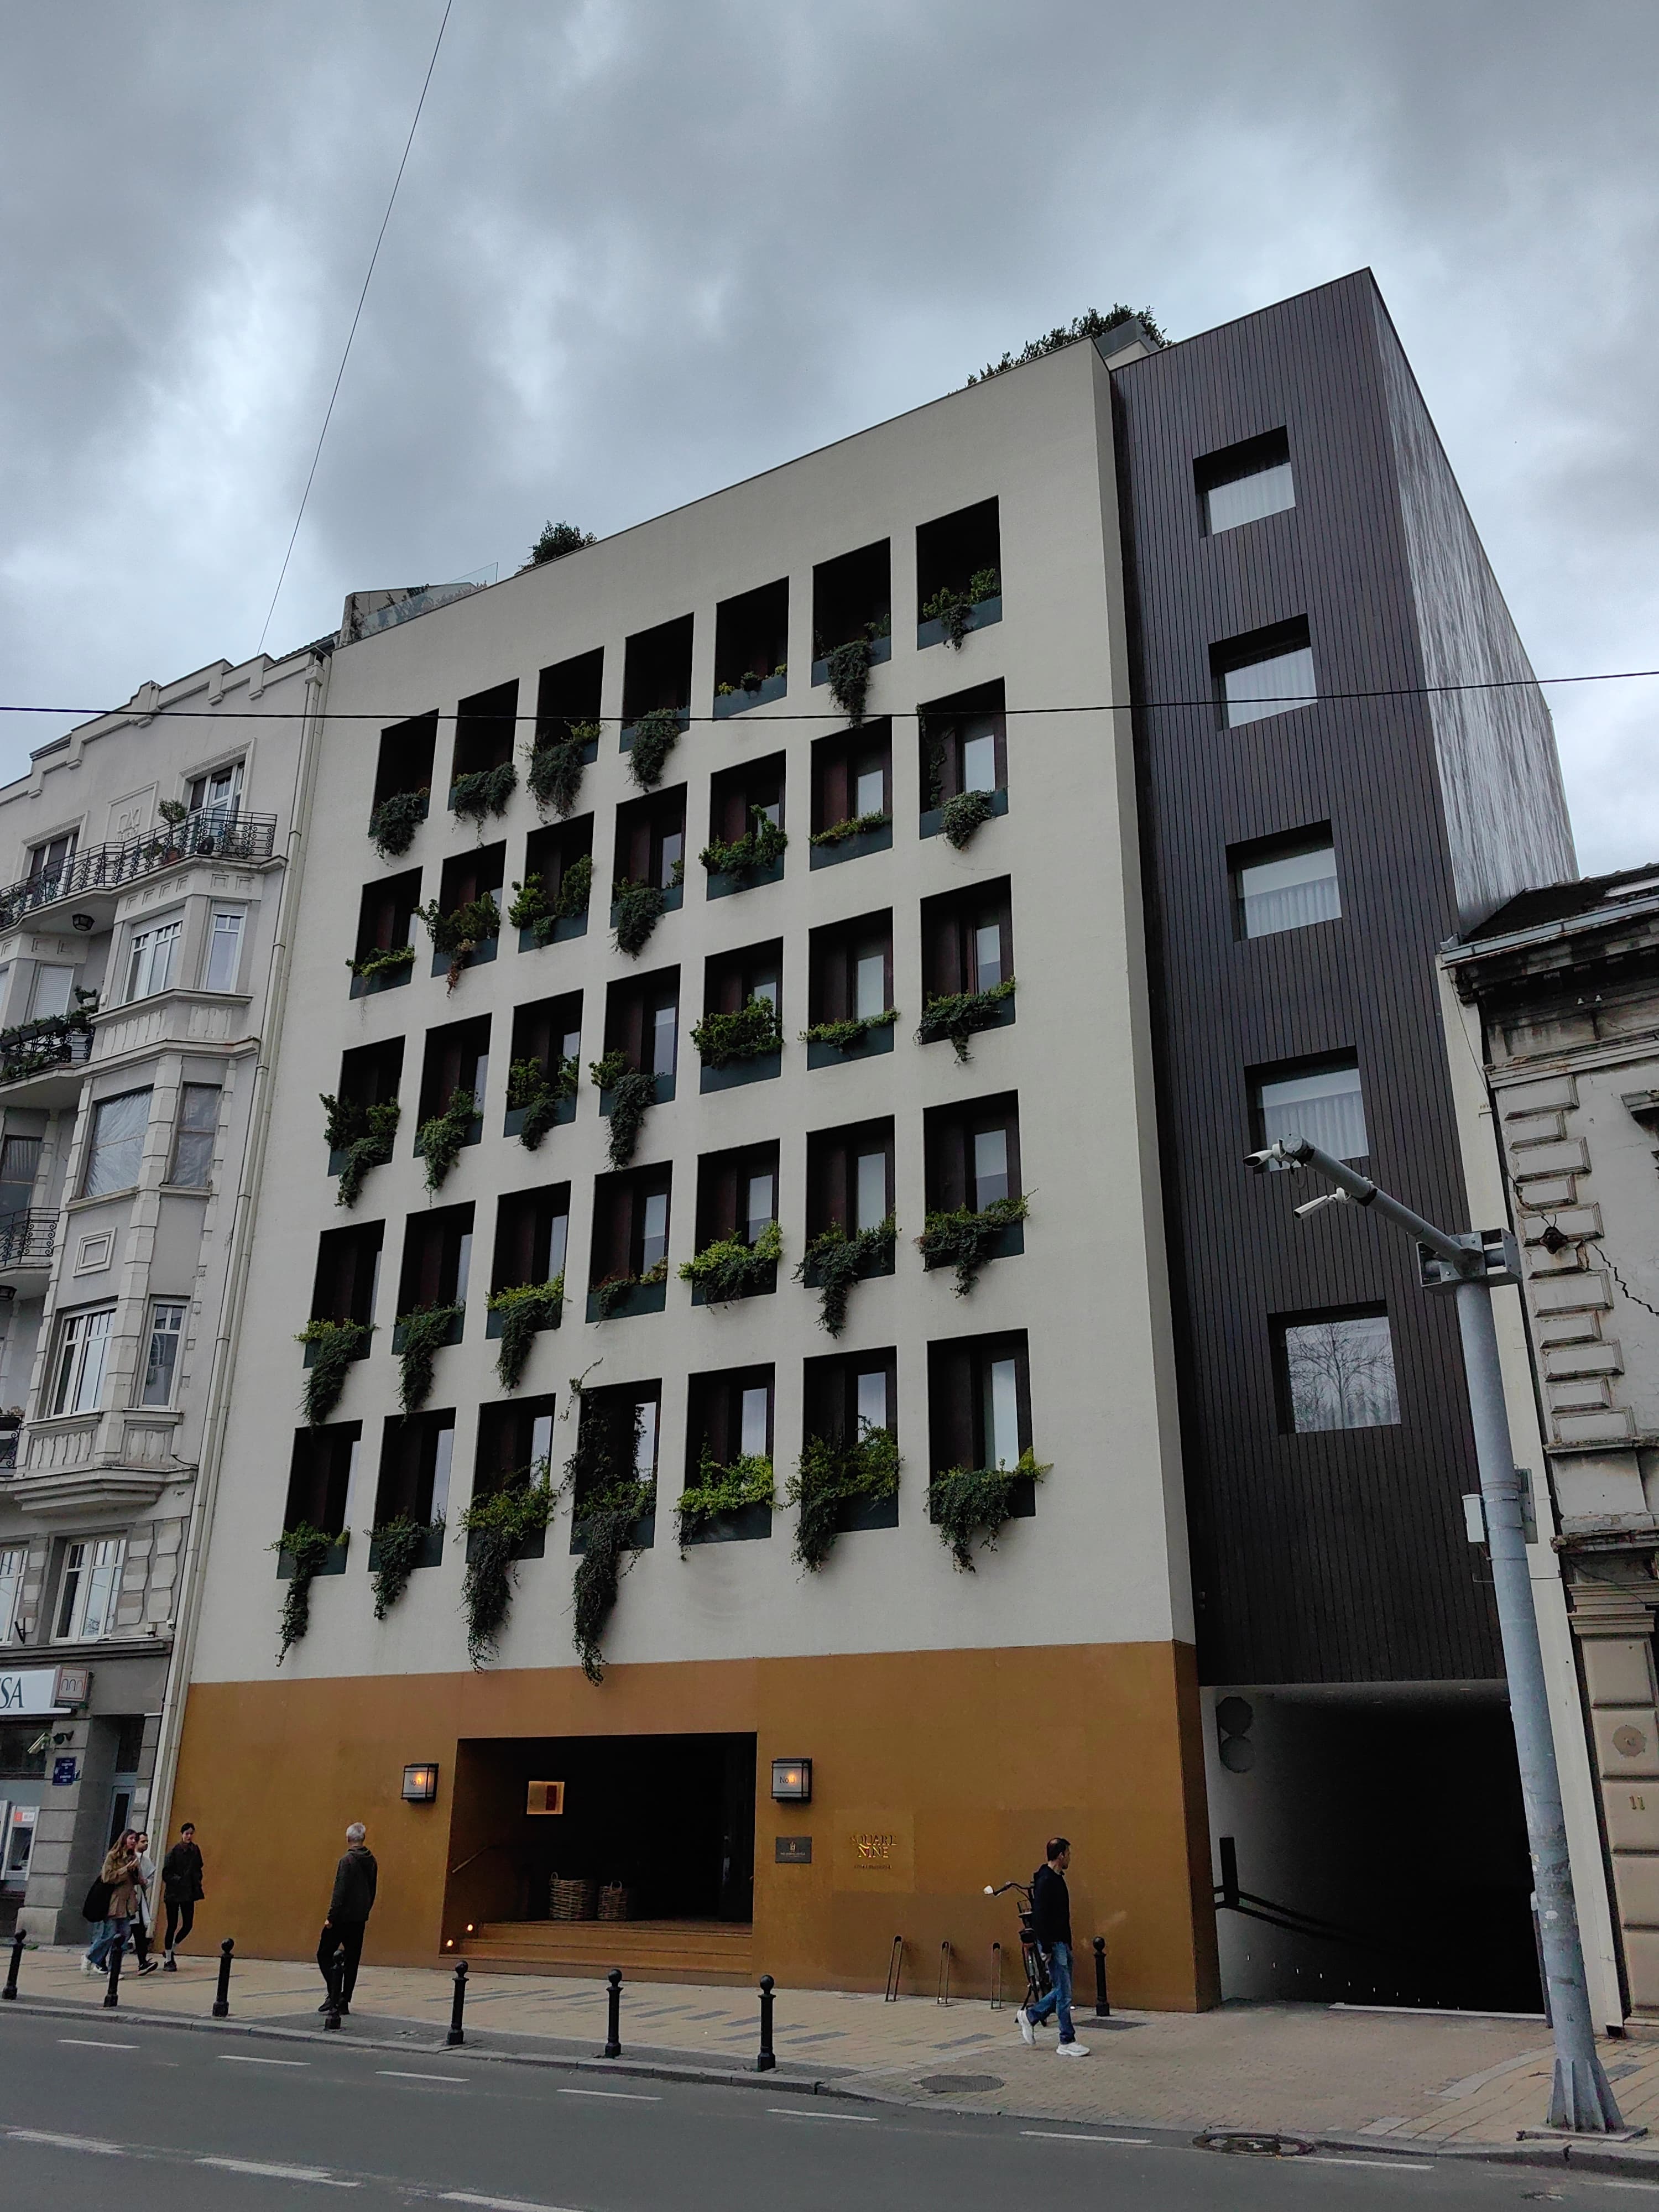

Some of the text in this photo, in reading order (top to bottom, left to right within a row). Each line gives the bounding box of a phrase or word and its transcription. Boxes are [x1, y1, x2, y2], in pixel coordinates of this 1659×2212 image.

[0, 1677, 25, 1709] SA
[849, 1834, 898, 1848] SQUARE
[857, 1846, 889, 1858] NINE
